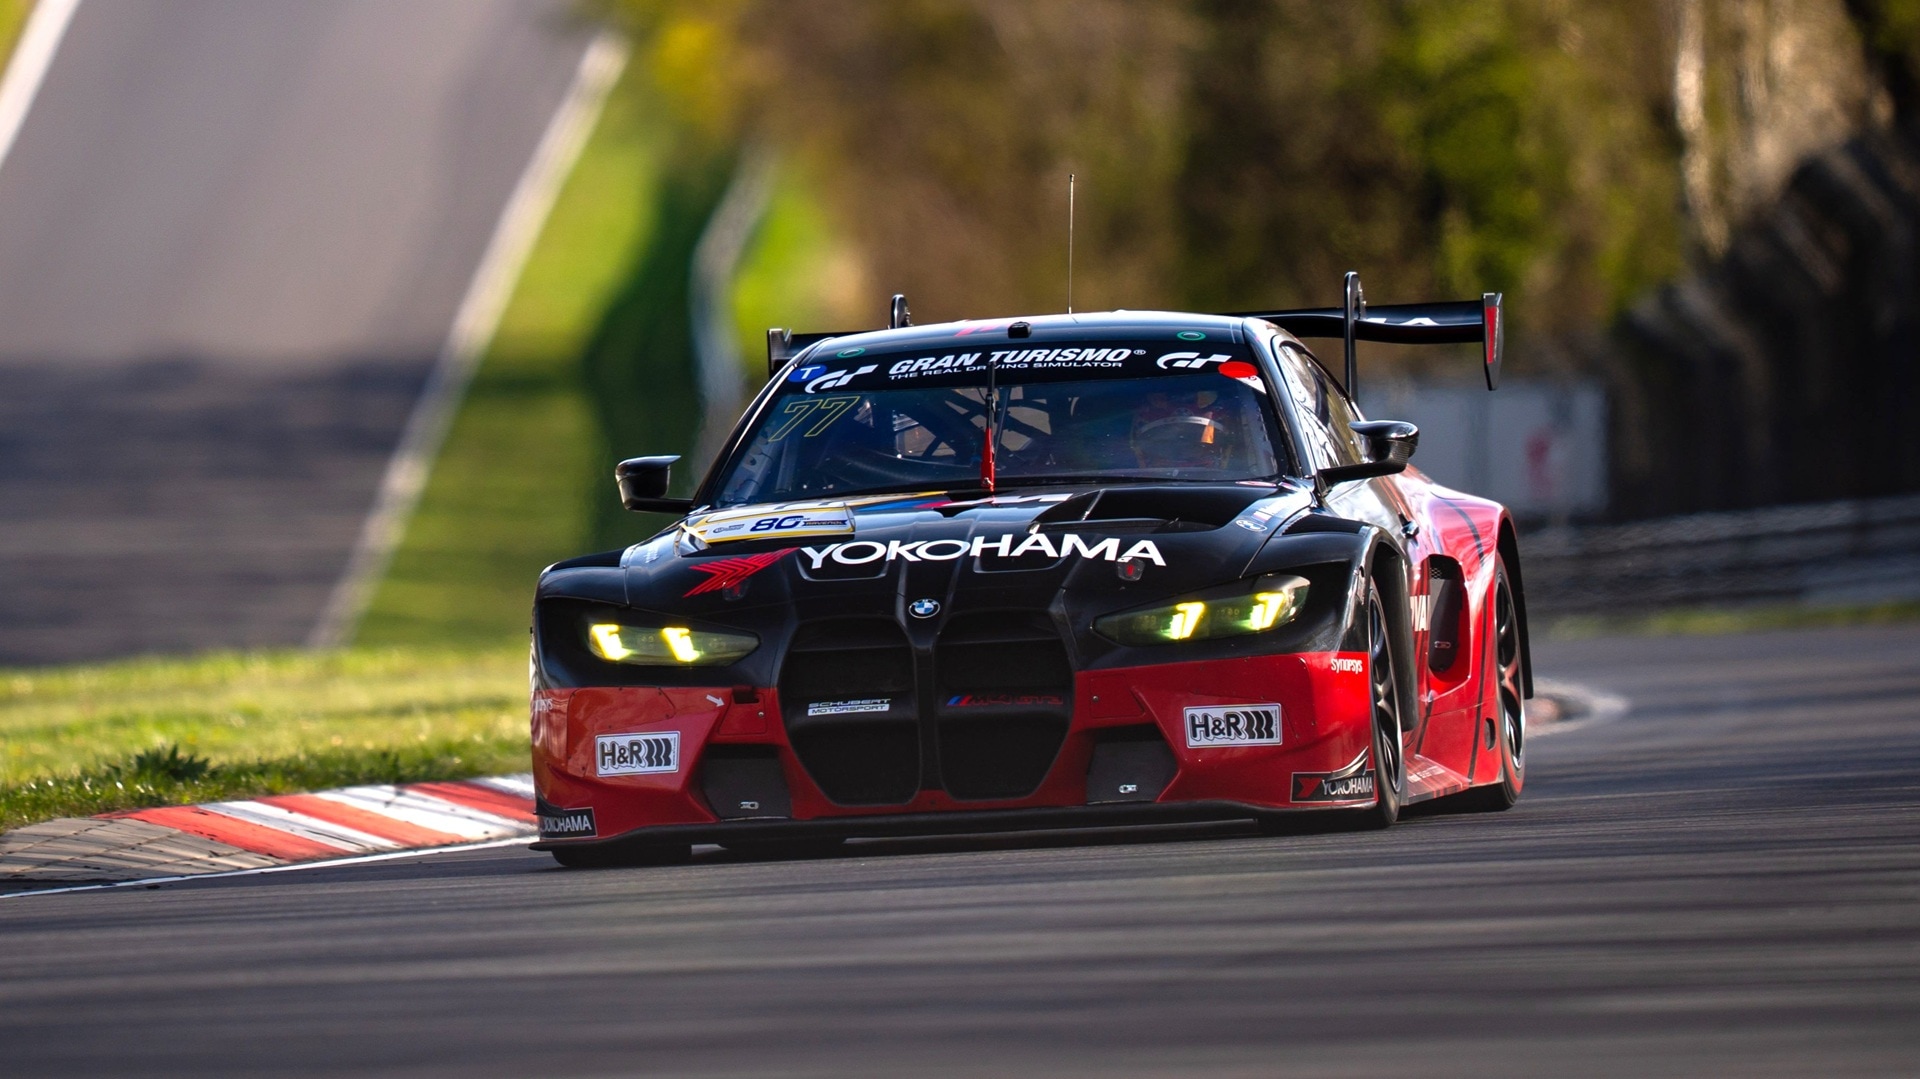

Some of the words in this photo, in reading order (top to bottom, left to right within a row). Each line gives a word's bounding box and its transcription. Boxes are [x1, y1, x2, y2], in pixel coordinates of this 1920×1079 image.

[800, 366, 821, 380] T
[888, 352, 982, 375] GRAN
[922, 366, 962, 376] REAL
[768, 396, 861, 442] 77
[750, 515, 805, 532] 80
[801, 533, 1167, 570] YOKOHAMA
[808, 698, 892, 708] SCHUBERT
[811, 704, 886, 715] MOTORSPORT
[1189, 711, 1247, 741] H&R
[600, 739, 646, 770] H&R
